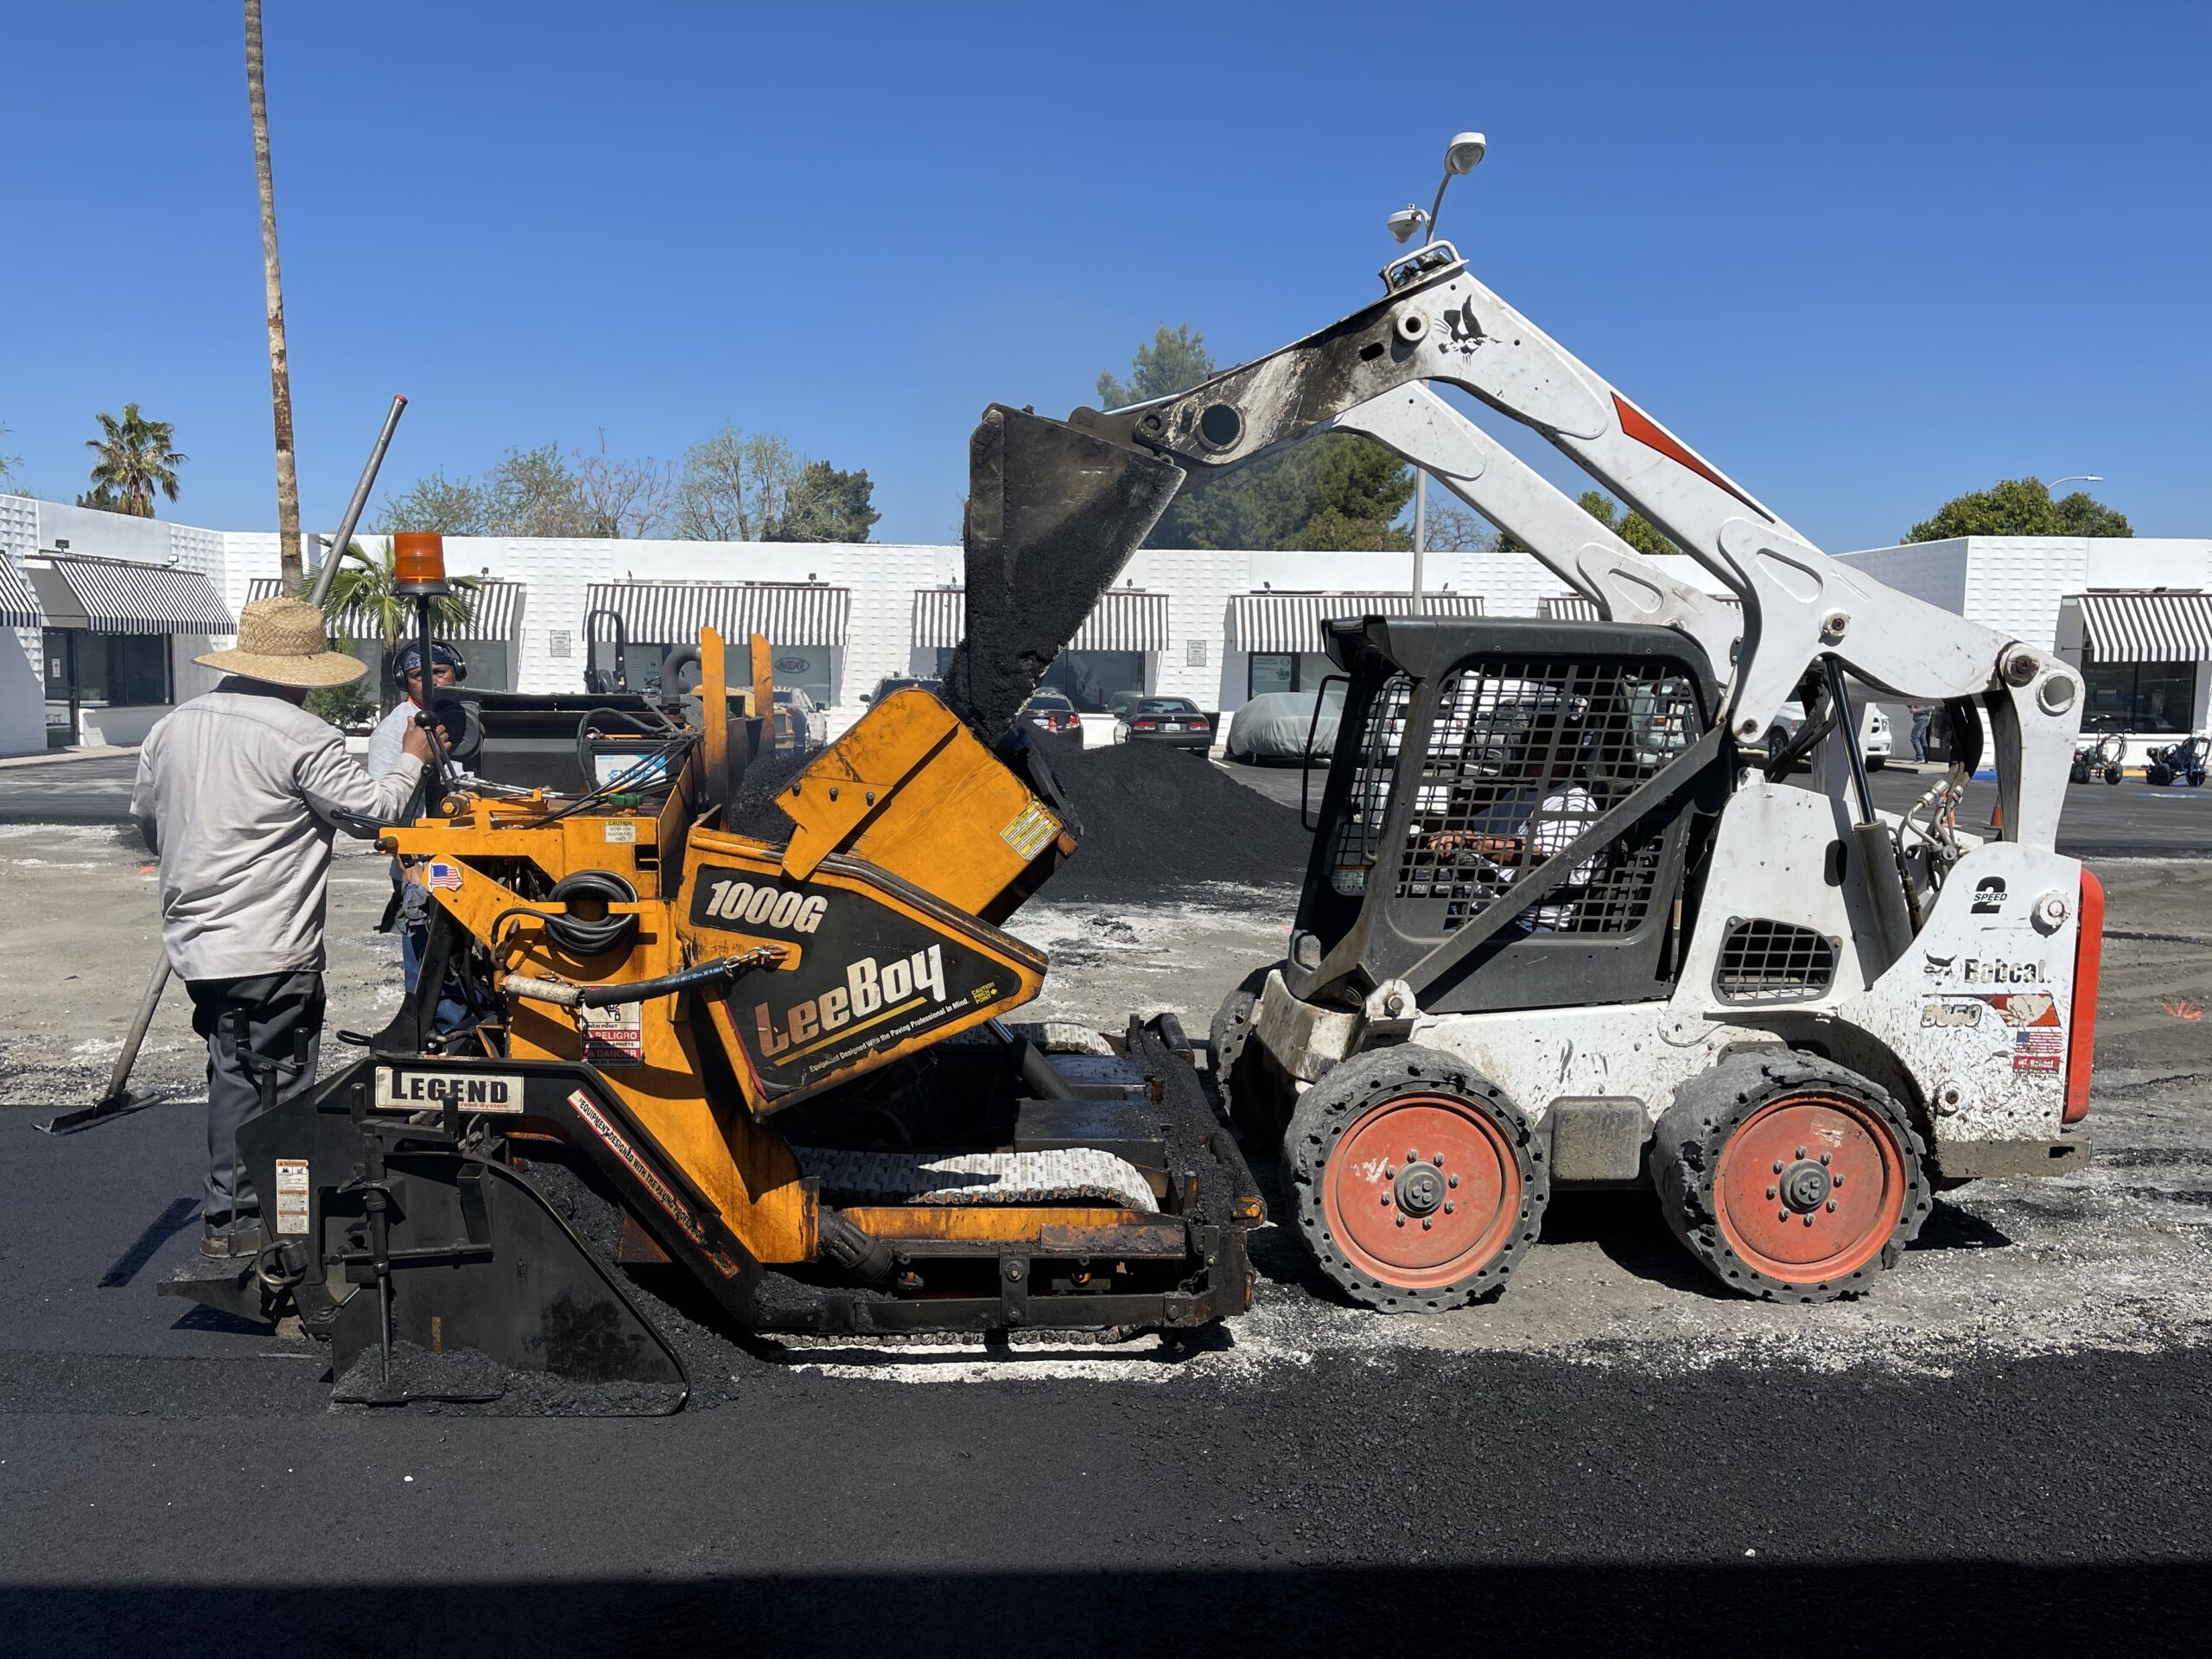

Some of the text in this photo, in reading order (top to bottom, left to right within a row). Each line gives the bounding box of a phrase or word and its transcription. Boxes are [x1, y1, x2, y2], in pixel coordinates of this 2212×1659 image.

[1013, 811, 1029, 827] CAUTION
[705, 880, 829, 934] 1000G
[1970, 876, 2006, 914] 2
[1974, 893, 2008, 901] SPEED
[754, 944, 946, 1058] LeeBoy
[971, 982, 995, 995] CAUTION
[973, 988, 990, 1000] PINCH
[976, 994, 992, 1004] POINT
[839, 1042, 868, 1059] Designed
[880, 1032, 891, 1042] the
[890, 1025, 912, 1037] Paving
[910, 1007, 946, 1028] Professional
[391, 1071, 508, 1103] LEGEND
[607, 1131, 633, 1162] DESIGNED
[632, 1158, 647, 1175] WITH
[645, 1174, 657, 1188] THE
[656, 1184, 675, 1209] PAVING
